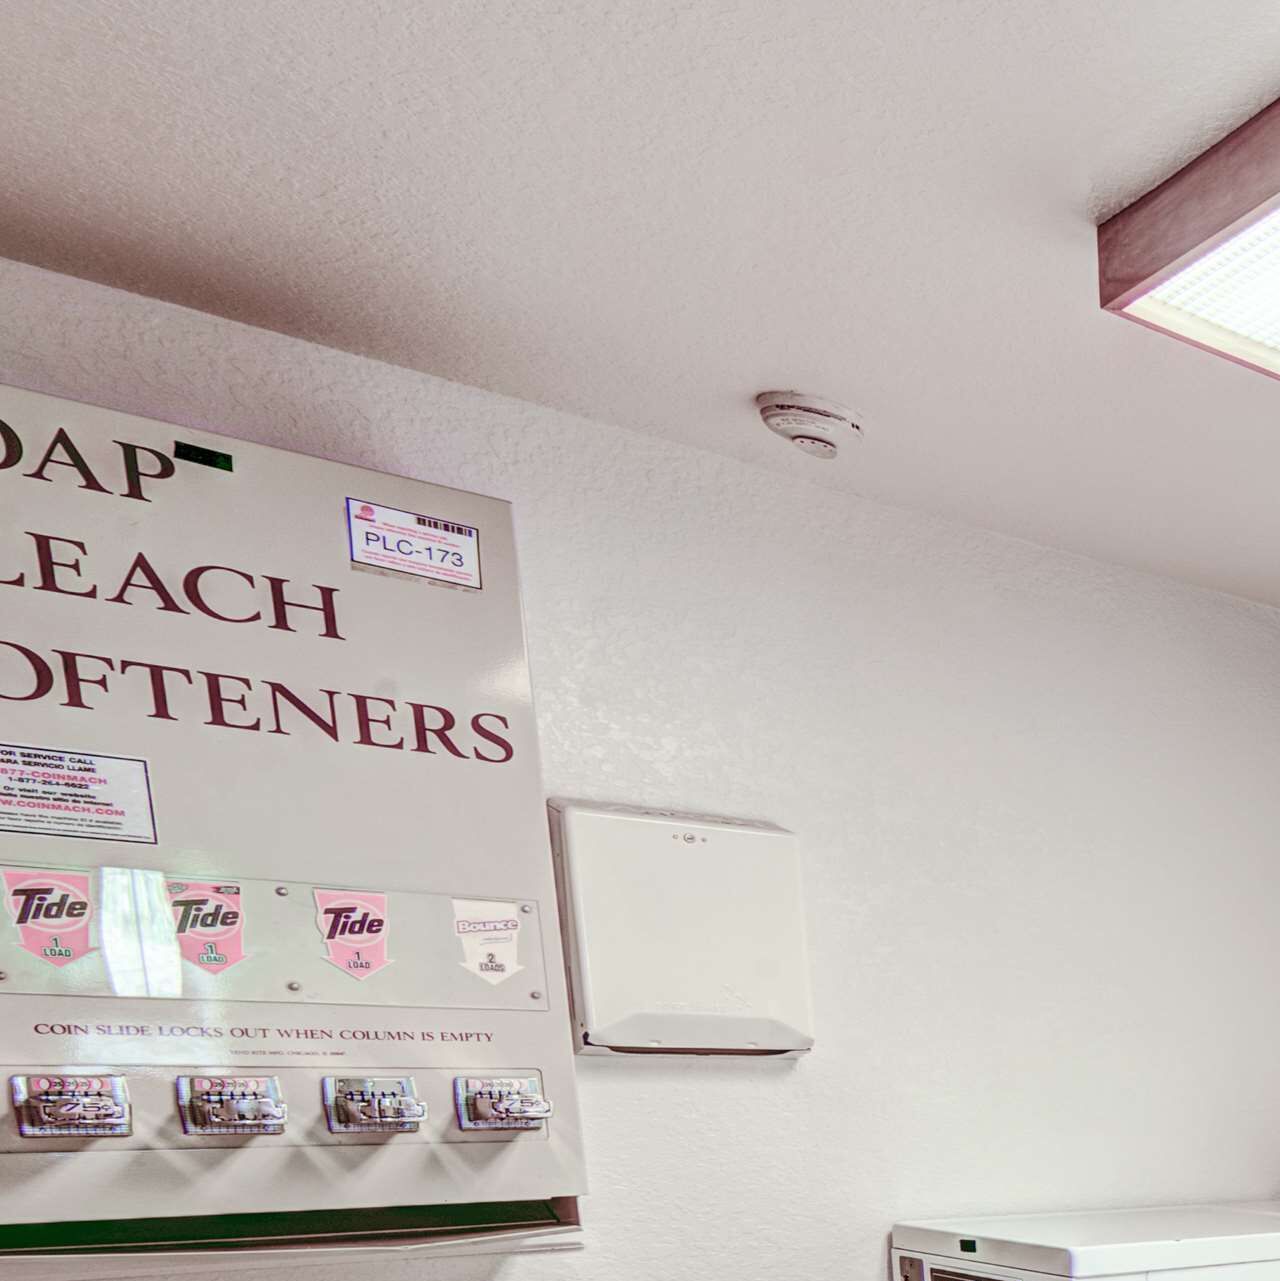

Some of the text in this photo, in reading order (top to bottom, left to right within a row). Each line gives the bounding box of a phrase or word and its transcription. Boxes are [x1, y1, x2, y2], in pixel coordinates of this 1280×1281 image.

[365, 531, 464, 567] PLC-173
[20, 752, 96, 765] SERVICE CALL
[21, 760, 65, 770] SERVICIO
[12, 887, 88, 924] Tide
[172, 898, 239, 934] Tide
[323, 907, 384, 939] Tide
[457, 920, 519, 933] Bounce
[52, 937, 59, 948] 1
[43, 948, 71, 957] LOAD
[206, 943, 216, 955] 1
[200, 955, 225, 963] LOAD
[355, 952, 360, 961] 1
[487, 953, 495, 963] 2
[348, 960, 370, 969] LOAD
[33, 1023, 493, 1042] COIN SLIDE LOCKS OUT WHEN COLUMN IS EMPTY
